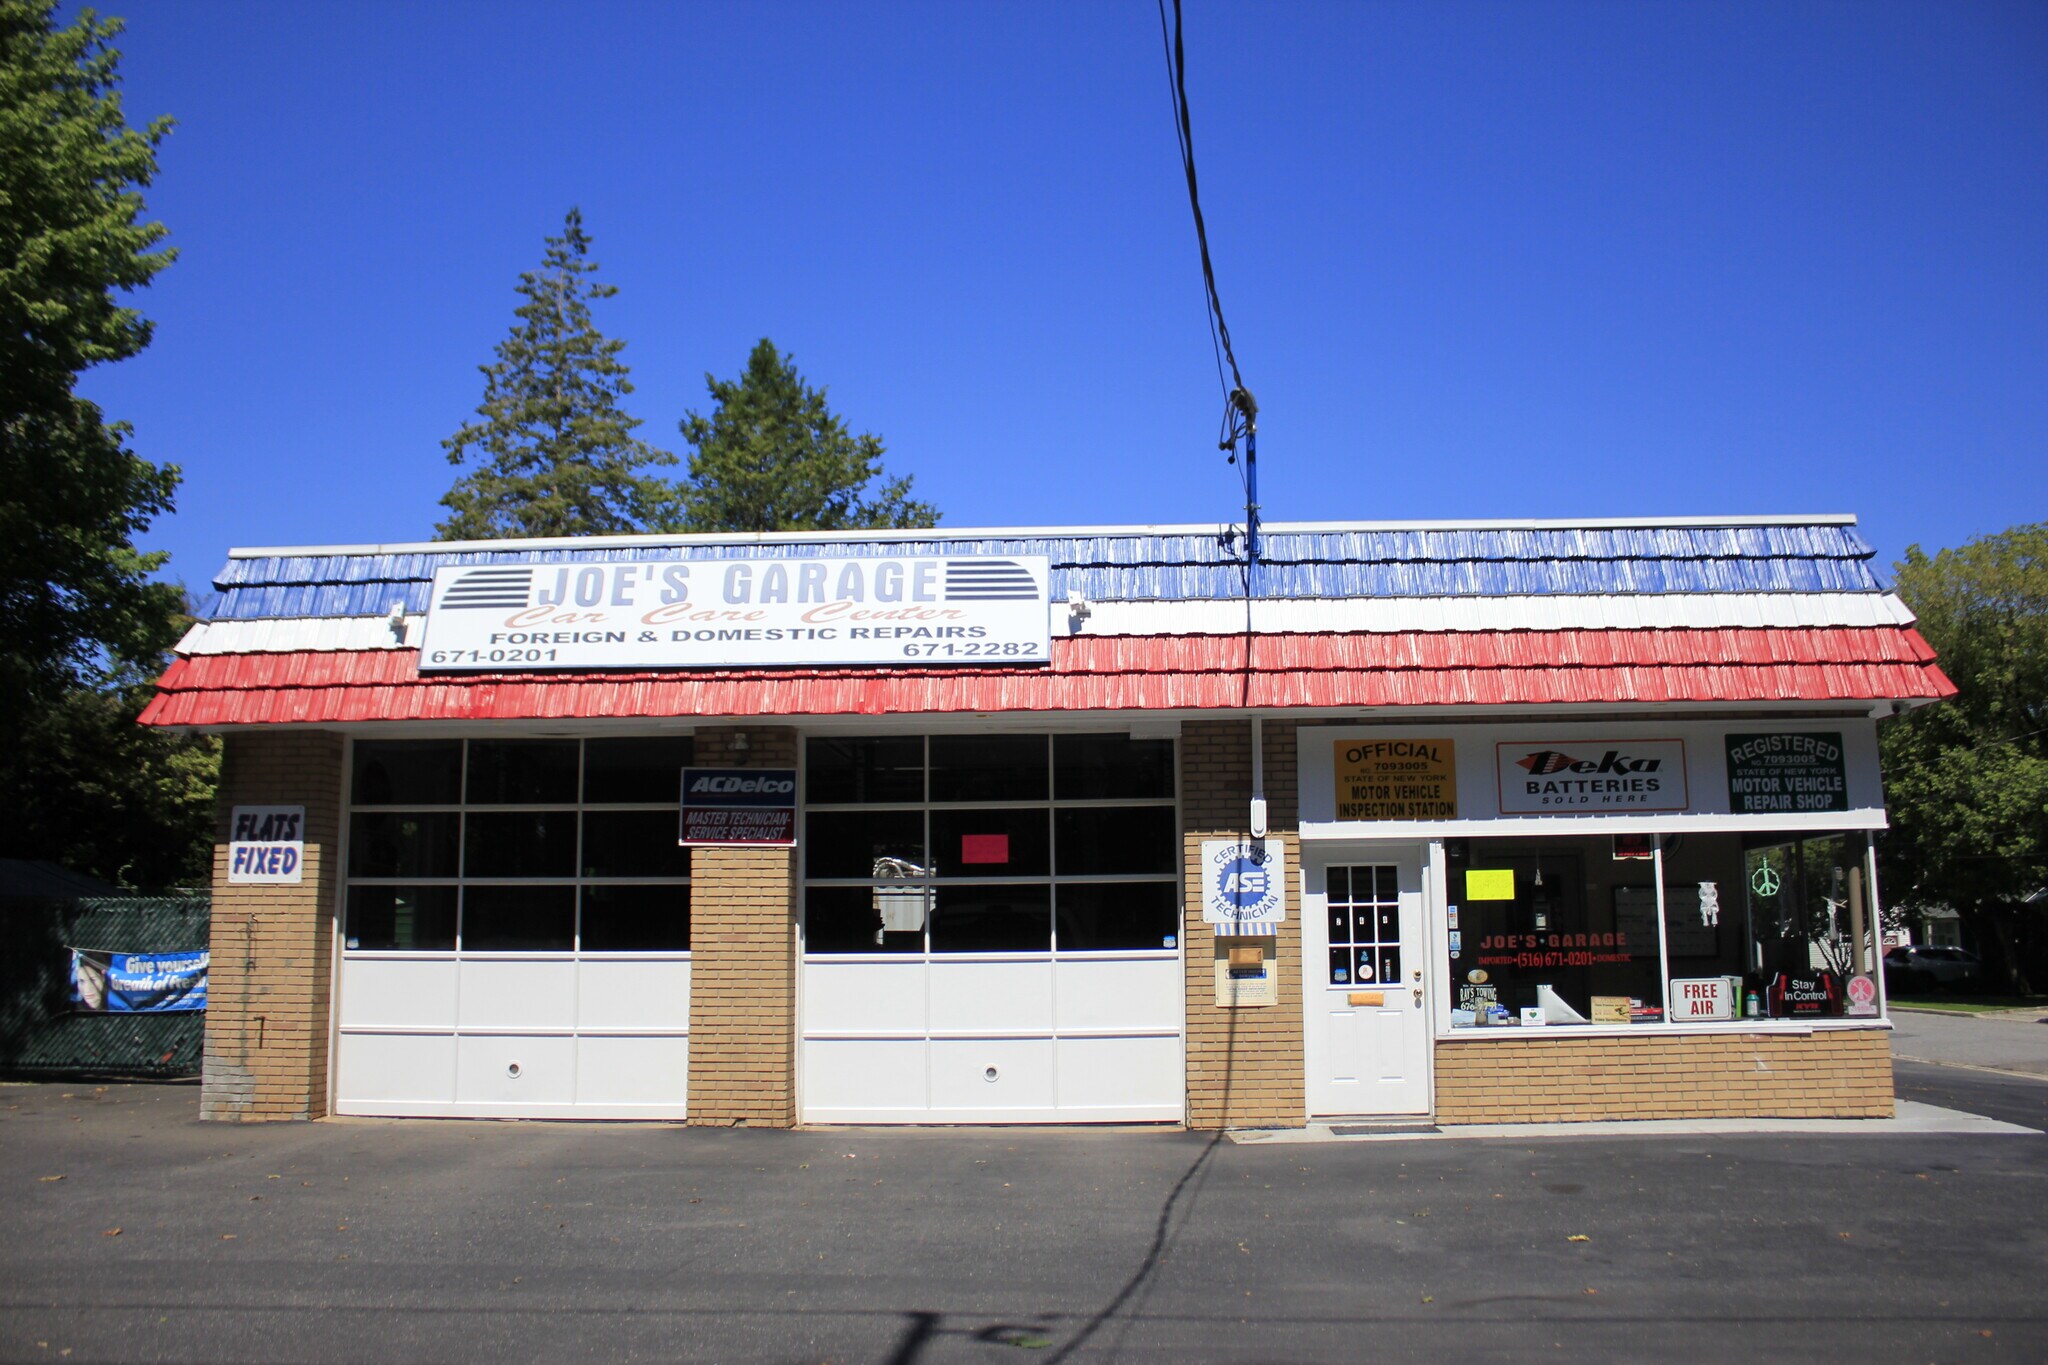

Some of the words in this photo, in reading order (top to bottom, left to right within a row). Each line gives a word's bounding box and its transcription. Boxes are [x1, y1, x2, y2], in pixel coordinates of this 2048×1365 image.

[538, 565, 690, 607] JOE'S
[722, 561, 938, 604] GARAGE
[504, 605, 609, 629] Car
[640, 602, 769, 625] Care
[800, 601, 968, 624] Center
[489, 630, 626, 644] FOREIGN
[637, 629, 658, 642] &
[671, 627, 838, 642] DOMESTIC
[849, 625, 987, 639] REPAIRS
[430, 649, 558, 663] 671-0201
[903, 641, 1039, 656] 671-2282
[1346, 742, 1442, 763] OFFICIAL
[1731, 735, 1839, 764] REGISTERED
[1374, 762, 1428, 770] 7093005
[1526, 750, 1661, 776] Deka
[1764, 755, 1816, 763] 7093005
[1344, 775, 1374, 783] STATE
[1784, 767, 1806, 775] NEW
[690, 776, 794, 793] ACDelco
[1352, 786, 1390, 800] MOTOR
[1395, 785, 1440, 799] VEHICLE
[1526, 778, 1661, 794] BATTERIES
[1732, 778, 1780, 793] MOTOR
[1785, 777, 1842, 792] VEHICLE
[1542, 796, 1589, 804] SOLD
[1602, 794, 1648, 803] HERE
[1744, 795, 1792, 810] REPAIR
[1796, 794, 1833, 809] SHOP
[1339, 802, 1405, 817] INSPECTION
[1408, 801, 1454, 816] STATION
[686, 811, 728, 825] MASTER
[729, 811, 792, 825] TECHNICIAN-
[236, 814, 299, 841] FLATS
[688, 826, 728, 839] SERVICE
[729, 825, 786, 839] SPECIALIST
[233, 847, 297, 875] FIXED
[1214, 844, 1273, 864] CERTIFIED
[1223, 872, 1265, 893] ASE
[1211, 895, 1279, 920] TECHNICIAN
[1480, 935, 1537, 949] JOE'S
[1548, 932, 1627, 947] GARAGE
[126, 956, 155, 974] Give
[111, 973, 153, 991] breath
[153, 974, 171, 991] of
[1792, 979, 1816, 991] Stay
[1683, 984, 1718, 999] FREE
[1784, 992, 1793, 1000] In
[1794, 990, 1827, 1001] Control
[1691, 1001, 1714, 1015] AIR
